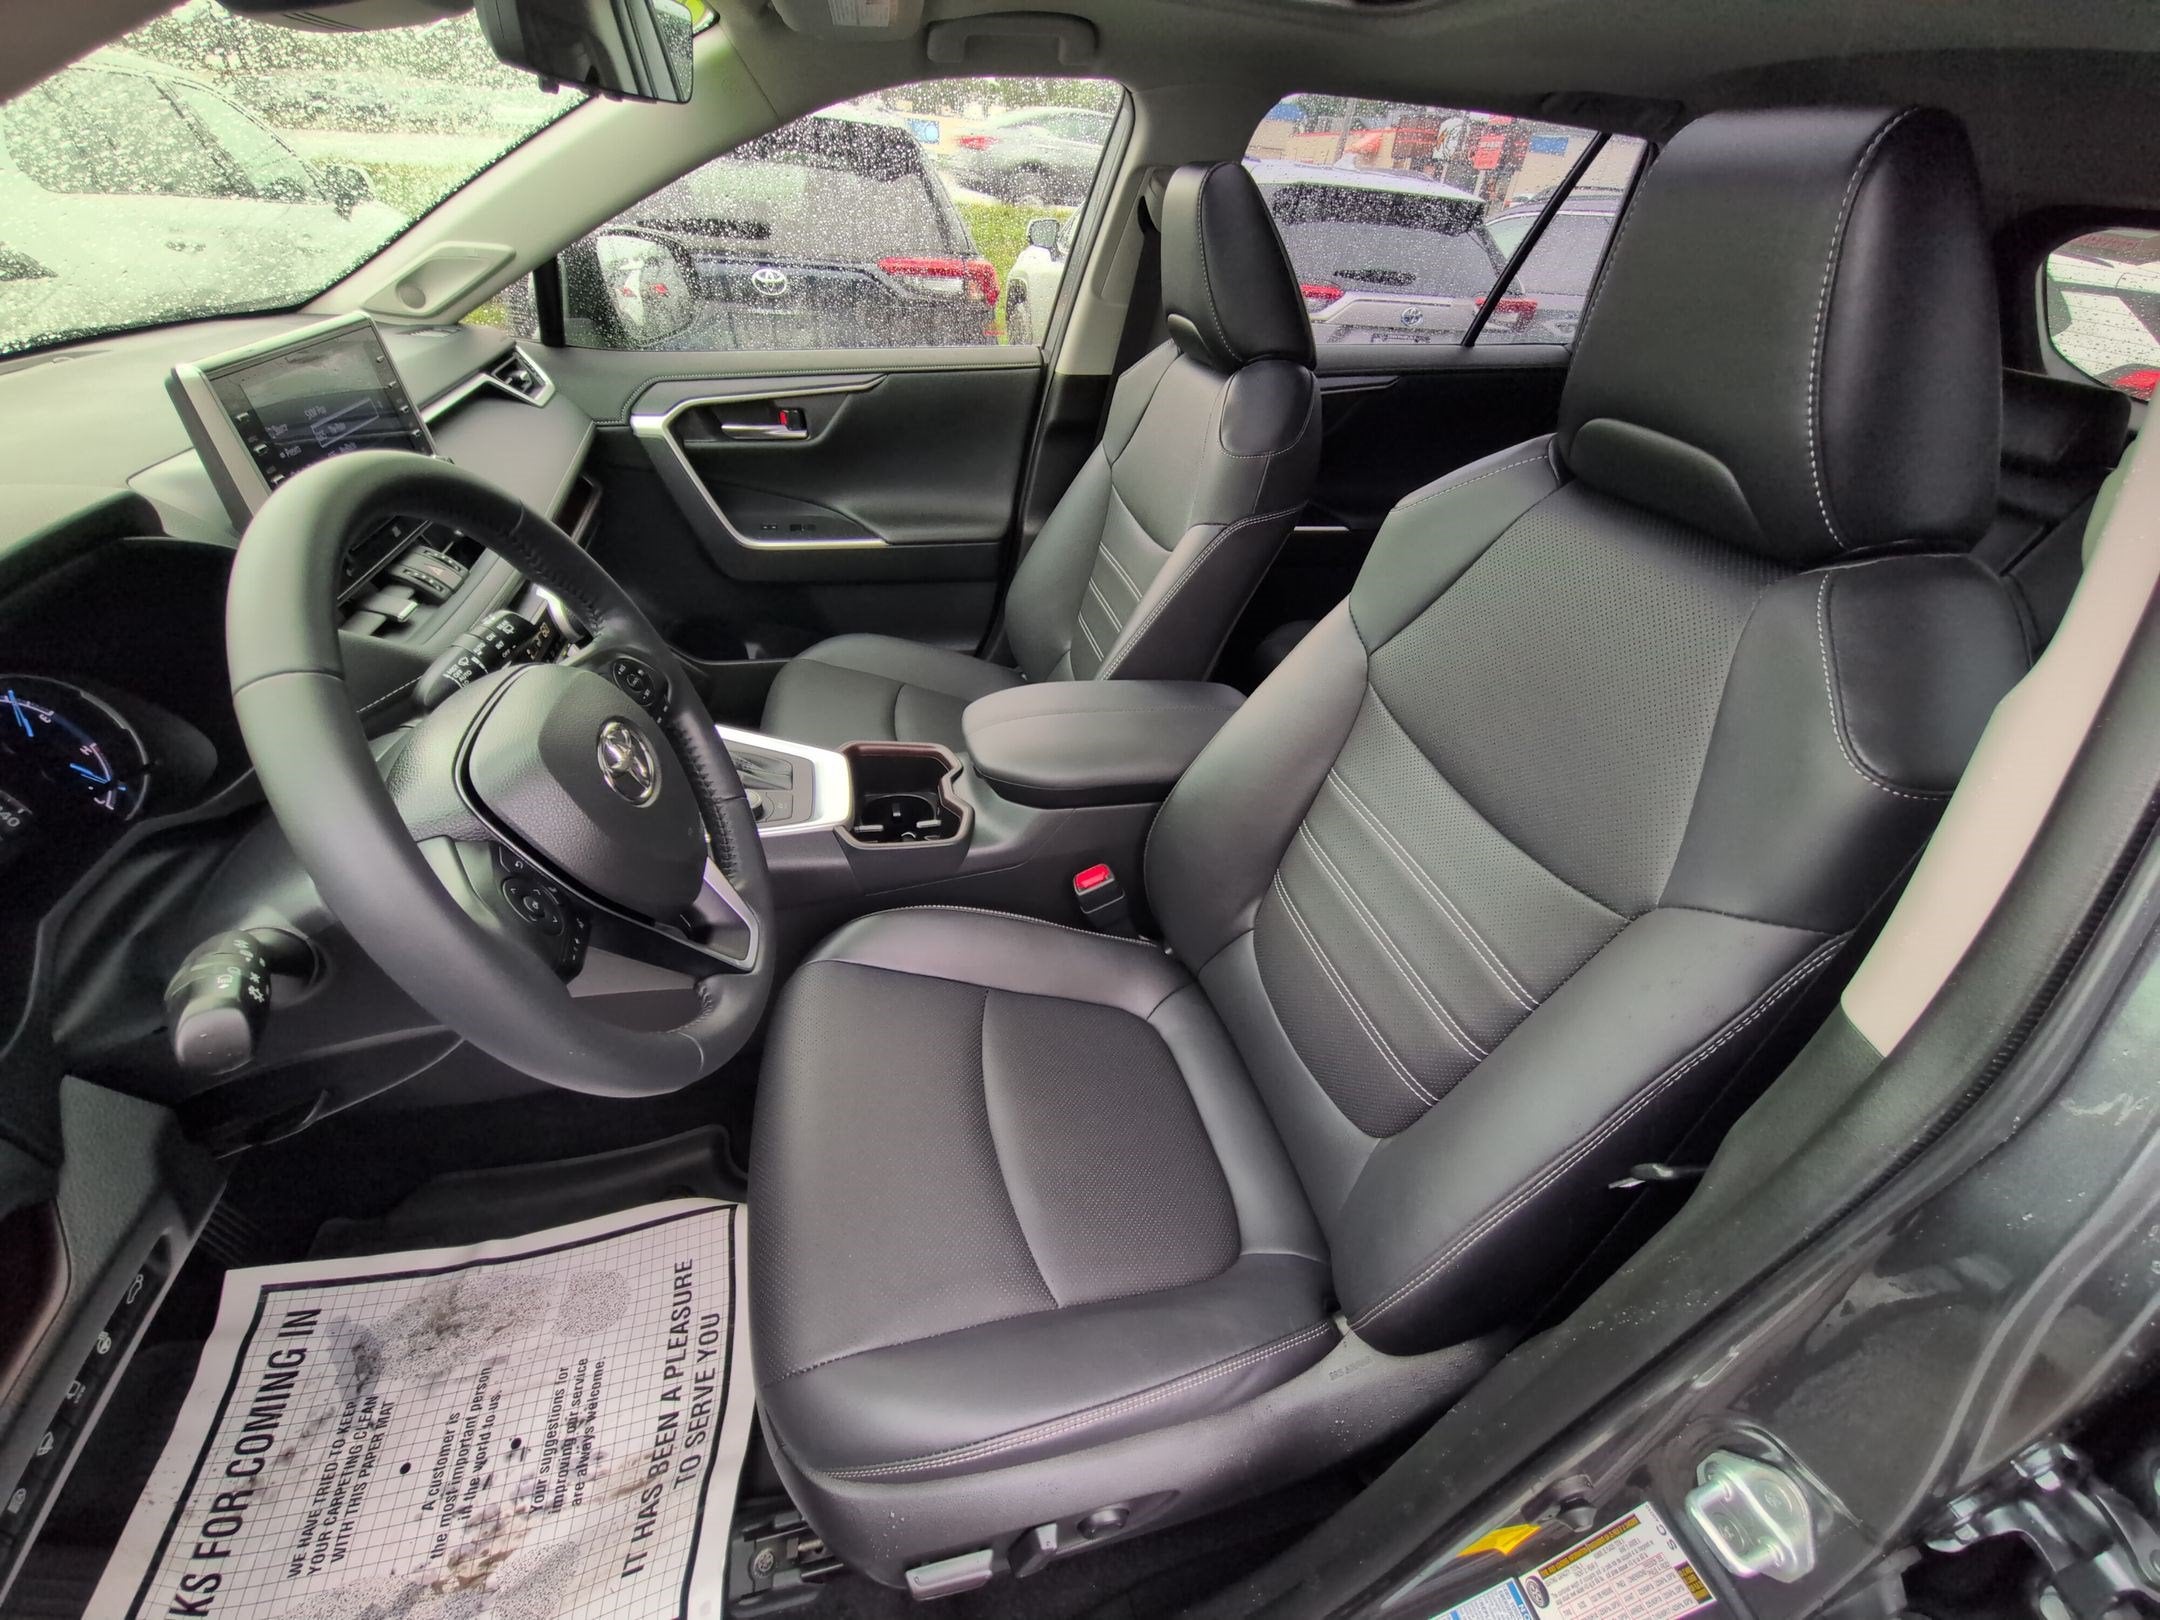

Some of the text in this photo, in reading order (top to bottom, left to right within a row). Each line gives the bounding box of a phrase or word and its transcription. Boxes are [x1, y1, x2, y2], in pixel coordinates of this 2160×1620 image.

[458, 670, 473, 682] AUTO
[502, 648, 511, 658] OFF
[165, 1308, 322, 1620] KS FOR COMING IN
[421, 1411, 461, 1512] A customer is
[430, 1366, 493, 1560] the most important person
[458, 1390, 503, 1521] in the world to us.
[529, 1366, 570, 1515] Your suggestions for
[548, 1357, 589, 1515] improving our service
[576, 1425, 596, 1480] always
[621, 1258, 694, 1579] IT HAS BEEN A PLEASURE
[673, 1312, 721, 1491] TO SERVE YOU
[288, 1401, 358, 1578] WE HAVE TRIED TO KEEP
[307, 1395, 379, 1576] YOUR CARPETING CLEAN
[330, 1400, 395, 1563] WITH THIS PAPER MAT
[571, 1481, 586, 1507] are
